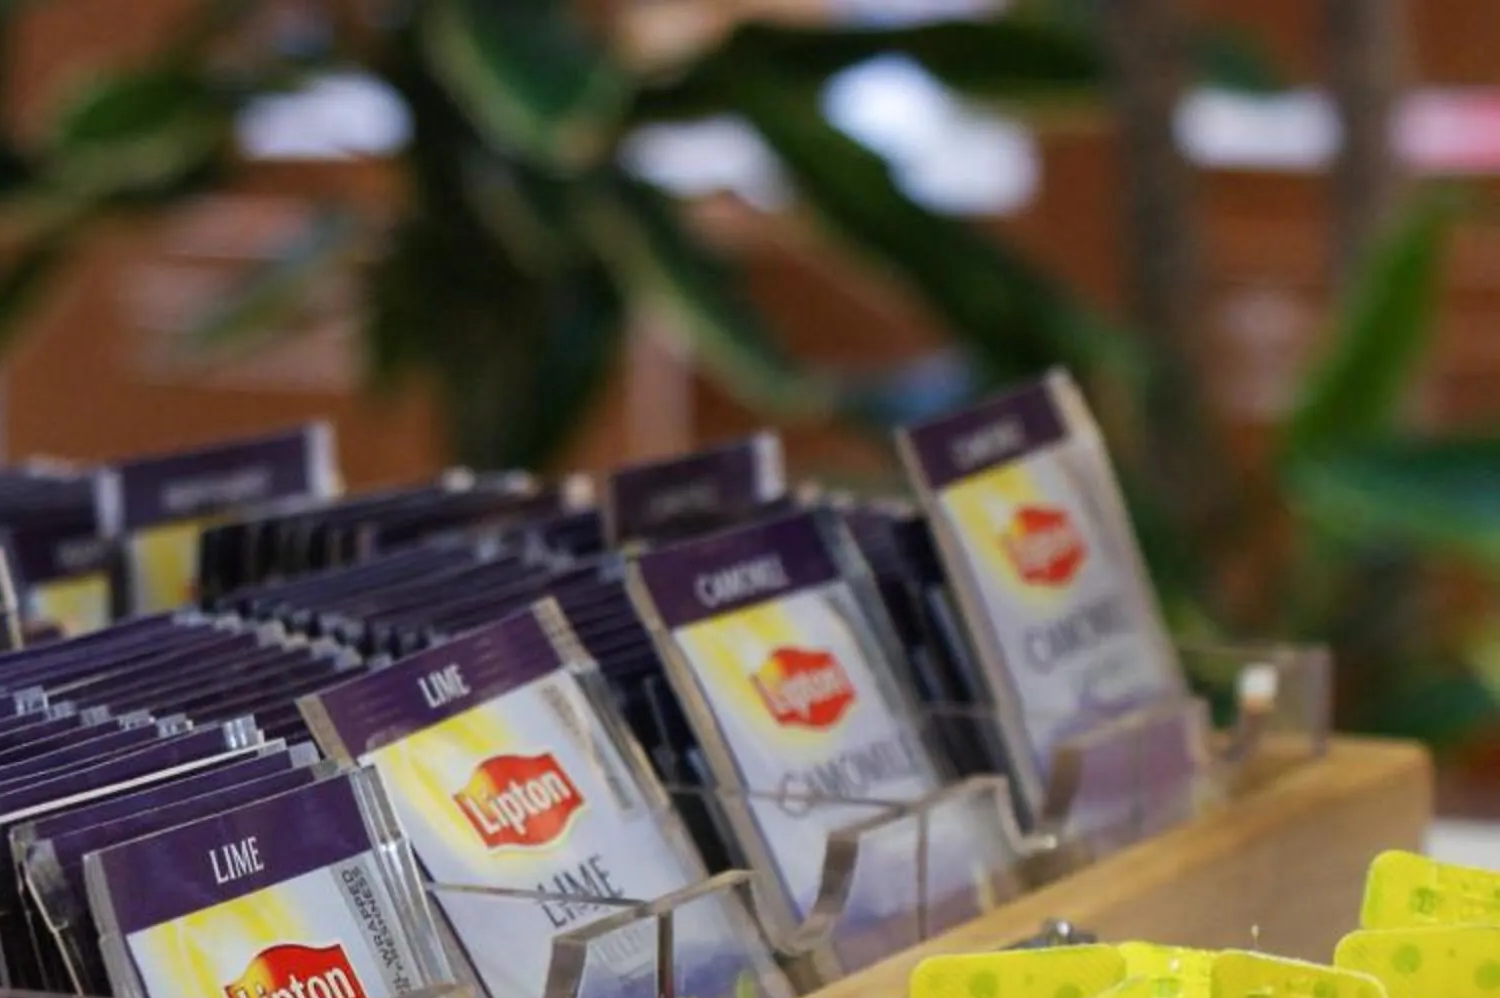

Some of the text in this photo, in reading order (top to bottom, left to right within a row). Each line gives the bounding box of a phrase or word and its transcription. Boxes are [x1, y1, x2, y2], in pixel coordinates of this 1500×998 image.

[417, 663, 471, 708] LIME
[463, 771, 572, 836] Lipton
[209, 836, 265, 884] LIME
[537, 855, 624, 929] LIME
